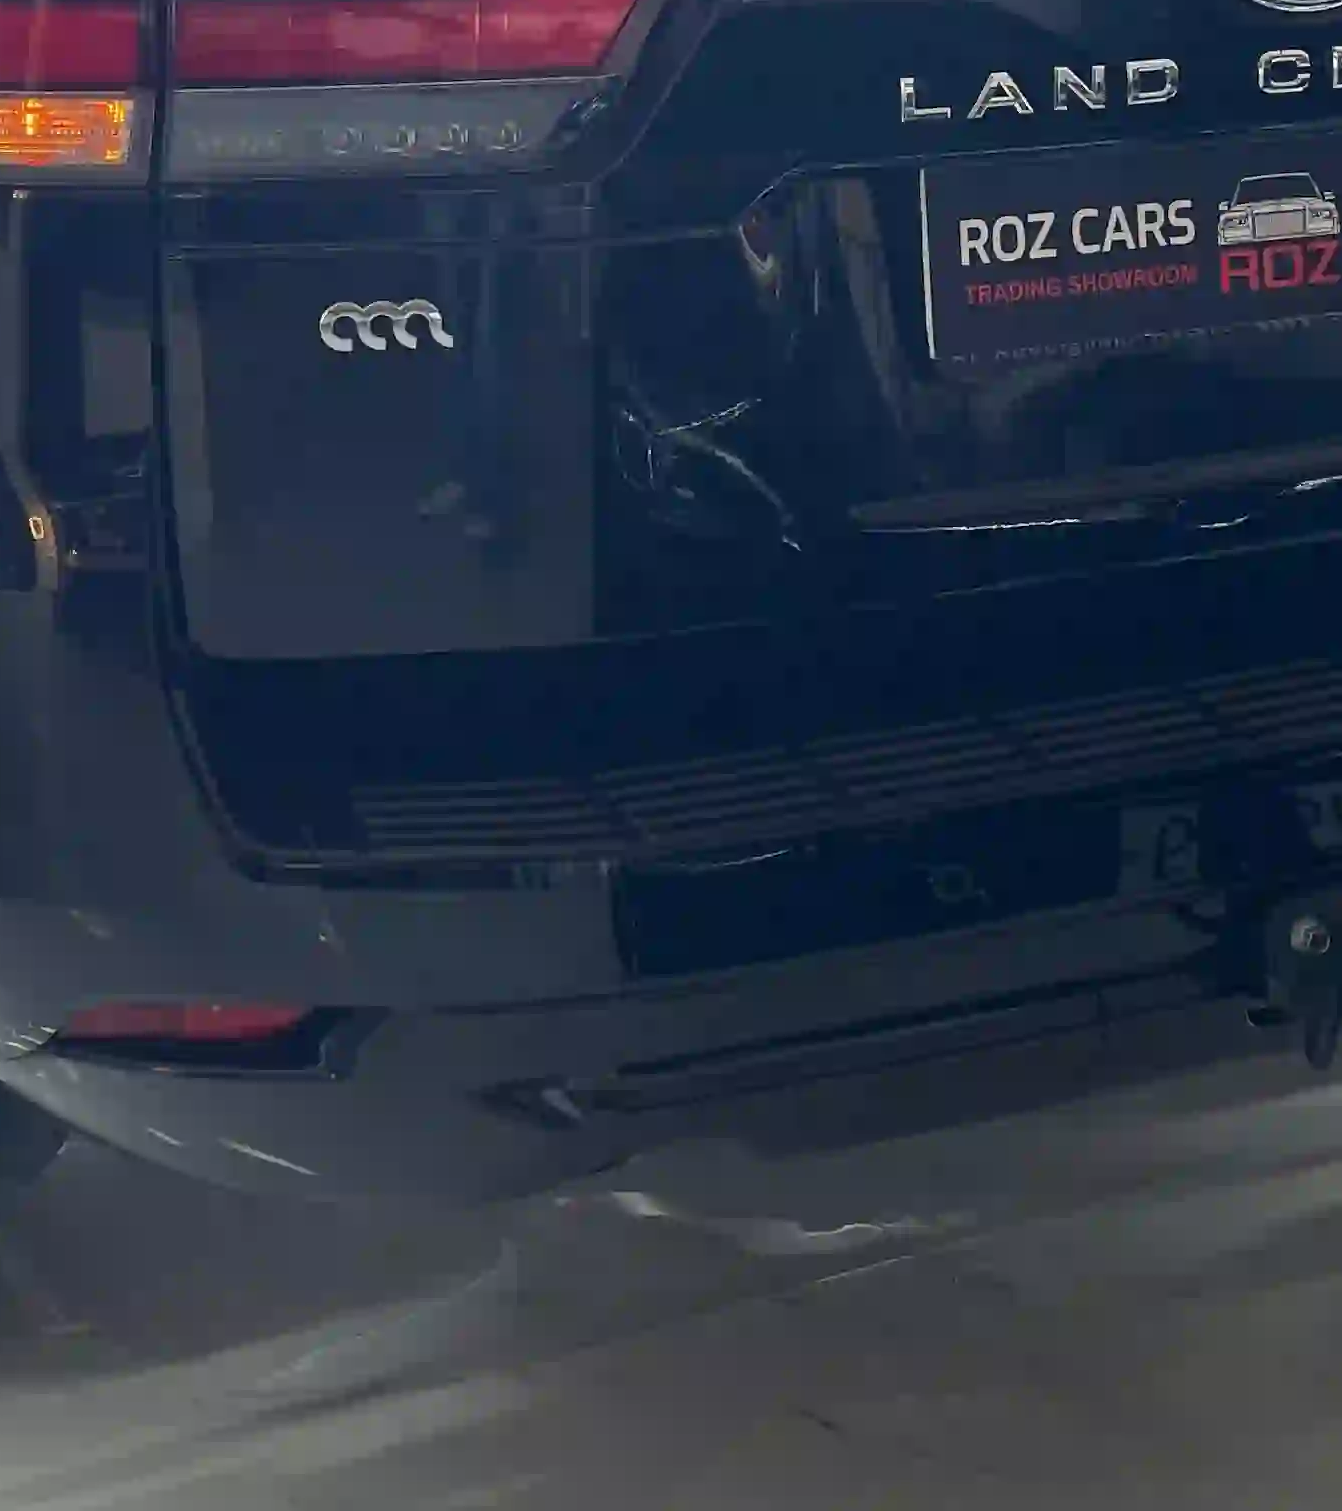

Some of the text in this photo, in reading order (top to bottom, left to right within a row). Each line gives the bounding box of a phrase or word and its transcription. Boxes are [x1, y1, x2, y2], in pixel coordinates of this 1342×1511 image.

[900, 58, 1179, 122] LAND
[959, 200, 1196, 266] ROZ CARS
[964, 264, 1198, 305] TRADING SHOWROOM
[1220, 238, 1341, 293] ROZ
